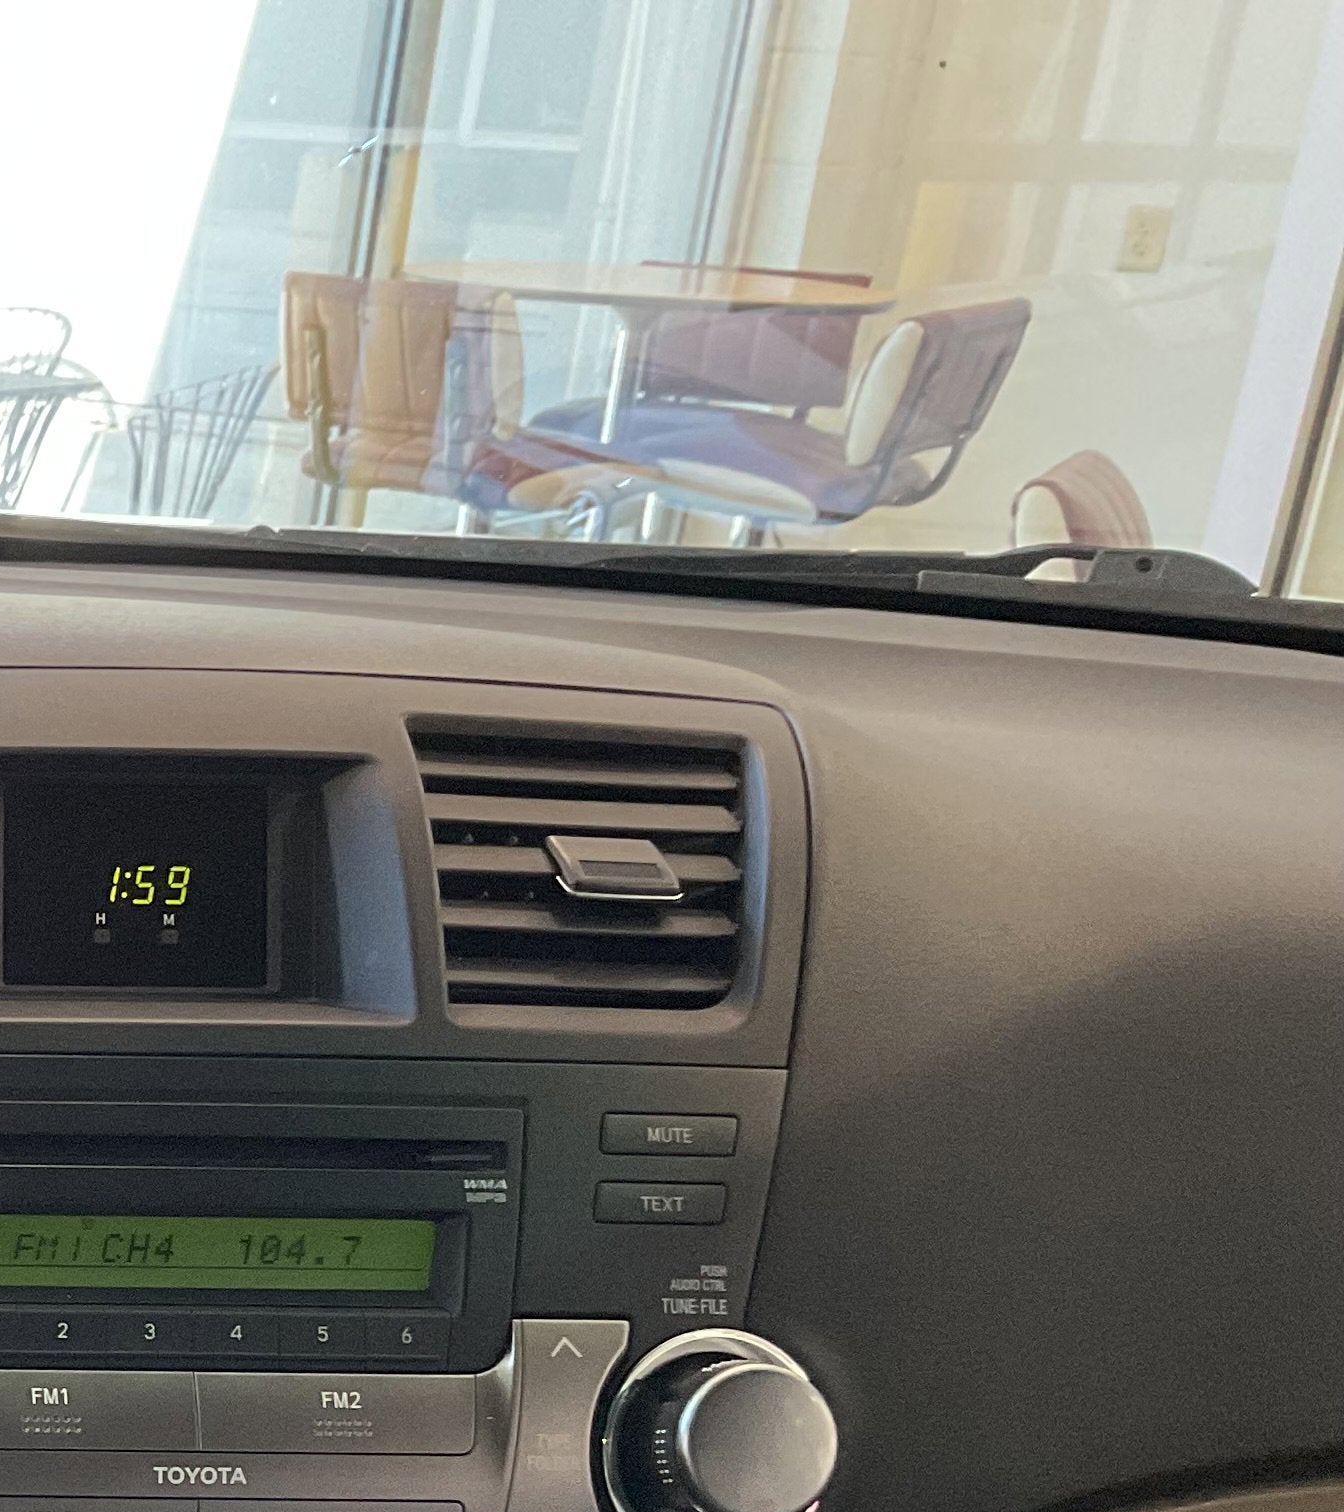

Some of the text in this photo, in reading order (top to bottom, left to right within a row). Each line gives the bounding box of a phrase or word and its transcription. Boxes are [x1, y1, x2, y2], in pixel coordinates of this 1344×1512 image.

[109, 865, 191, 905] 1:59
[95, 912, 106, 925] H
[163, 913, 175, 926] M
[646, 1127, 694, 1144] MUTE
[463, 1179, 508, 1190] WMA
[639, 1196, 685, 1212] TEXT
[101, 1233, 174, 1263] CH4
[239, 1234, 362, 1265] 104.7
[670, 1279, 728, 1292] AUDIO CTRL
[57, 1322, 69, 1339] 2
[144, 1323, 156, 1340] 3
[230, 1325, 242, 1341] 4
[317, 1326, 329, 1342] 5
[401, 1327, 413, 1344] 6
[31, 1388, 69, 1405] FM1
[320, 1391, 362, 1409] FM2
[153, 1466, 247, 1485] TOYOTA
